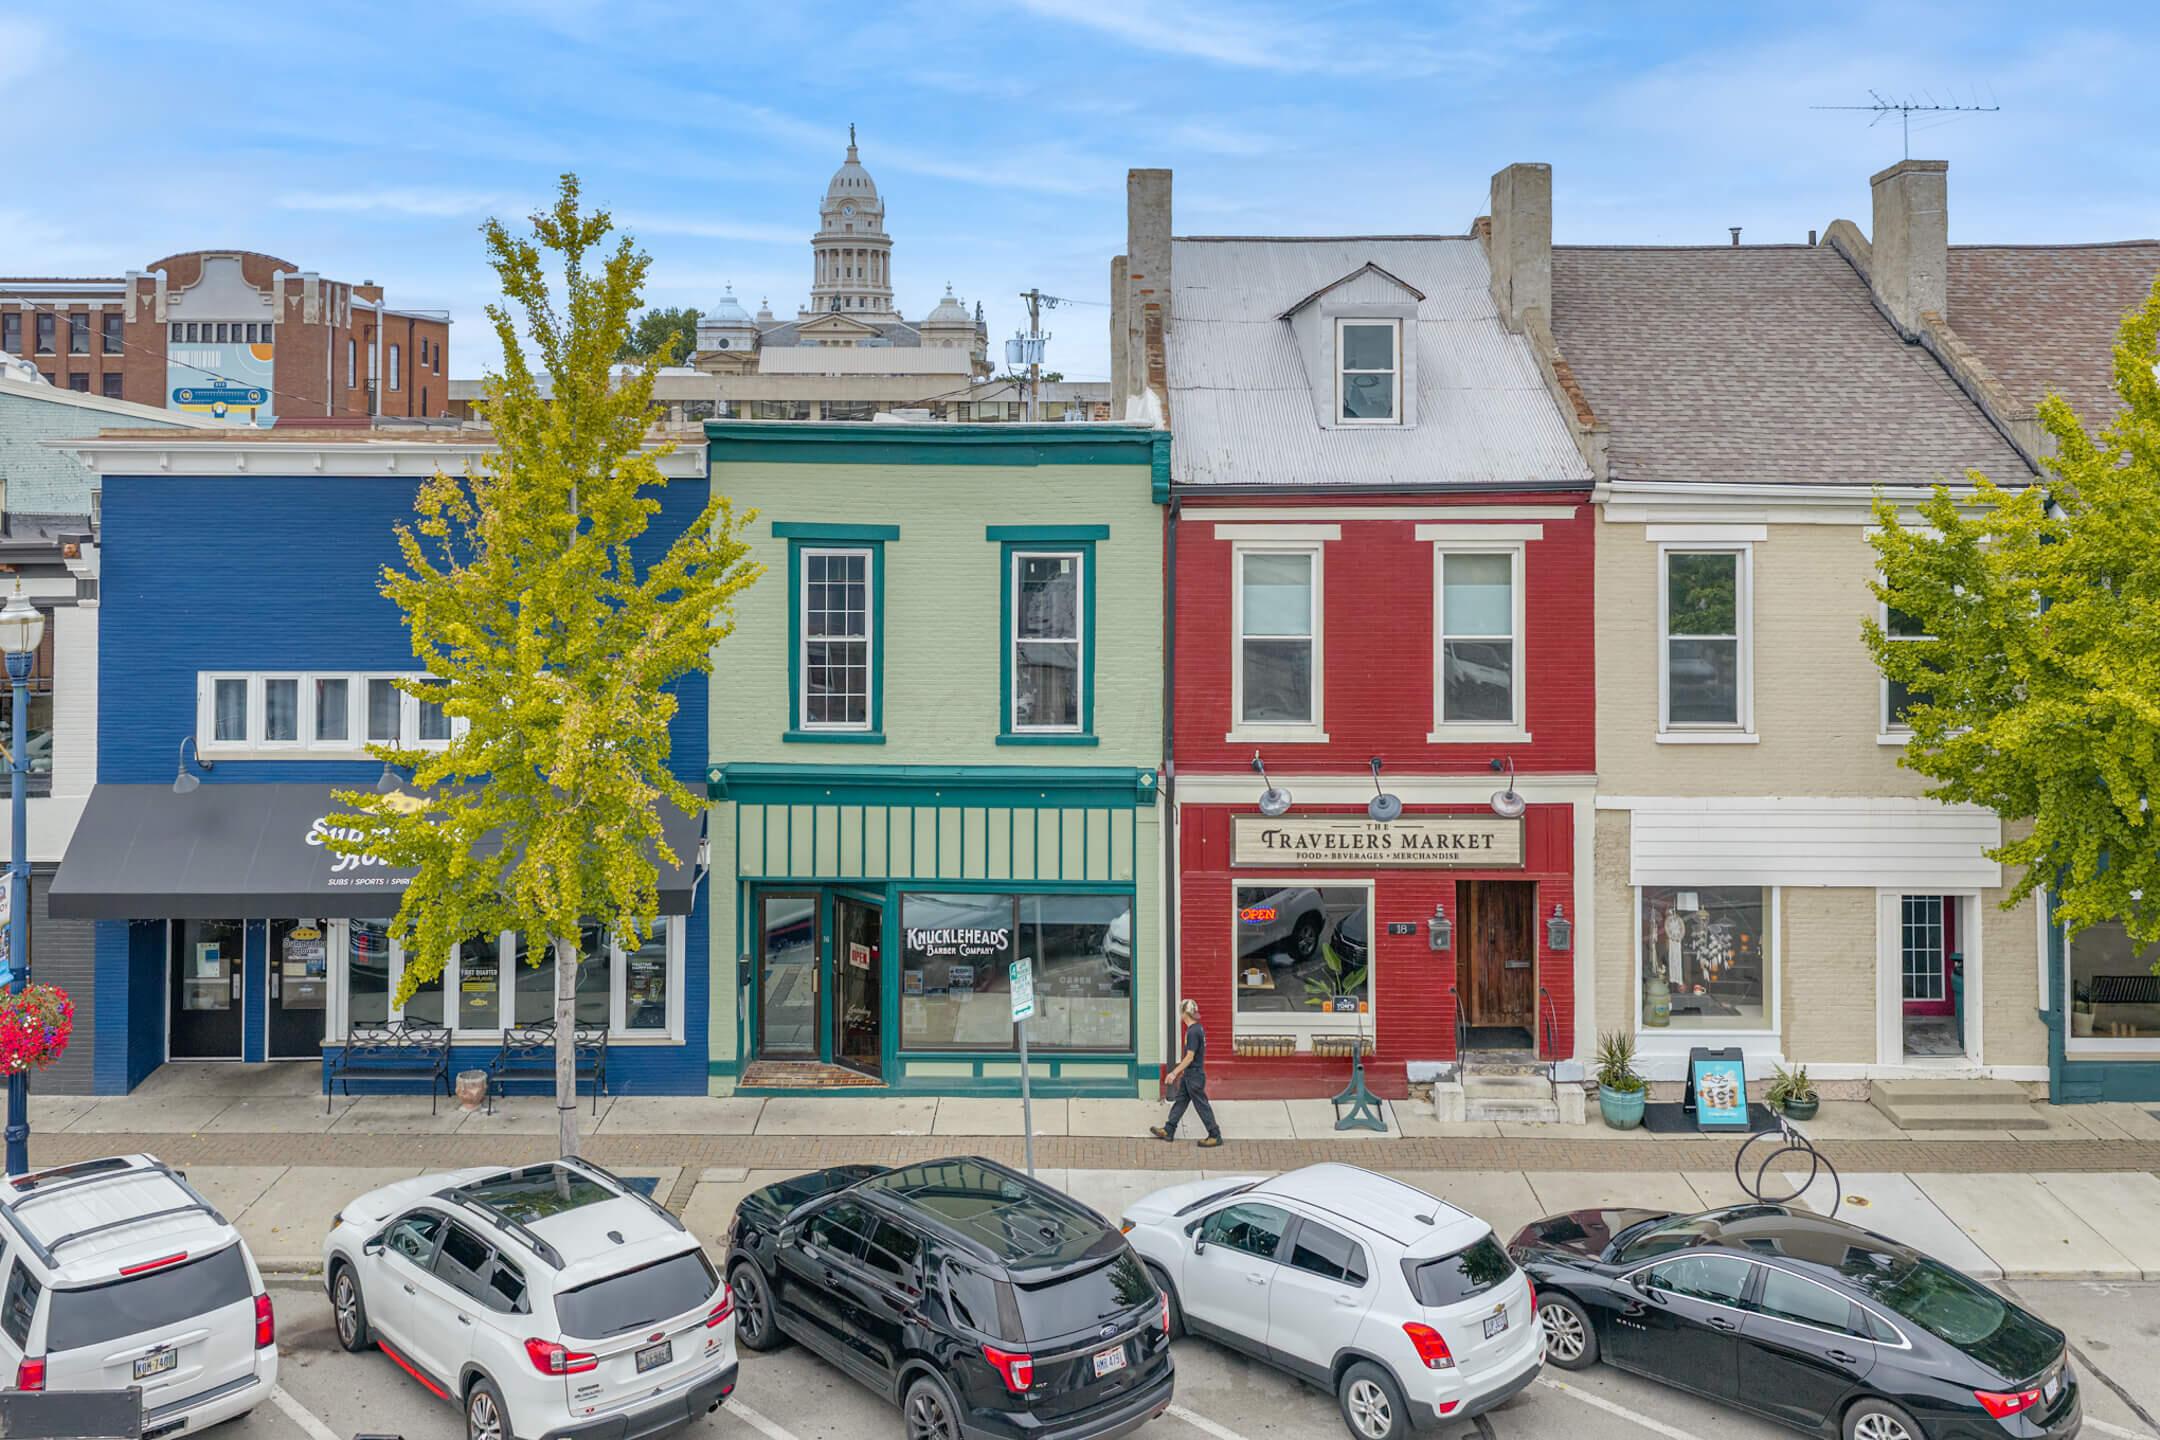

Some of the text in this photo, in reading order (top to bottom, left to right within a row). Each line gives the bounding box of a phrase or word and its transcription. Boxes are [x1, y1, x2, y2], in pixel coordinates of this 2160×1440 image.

[1366, 823, 1390, 831] THE
[1261, 828, 1495, 849] TRAVELERS MARKET
[1296, 852, 1460, 860] FOOD BEVERAGES MERCHANDISE
[327, 878, 349, 886] SUBS
[354, 878, 384, 886] SPORTS
[1240, 907, 1276, 921] OPEN
[1396, 924, 1408, 934] 18
